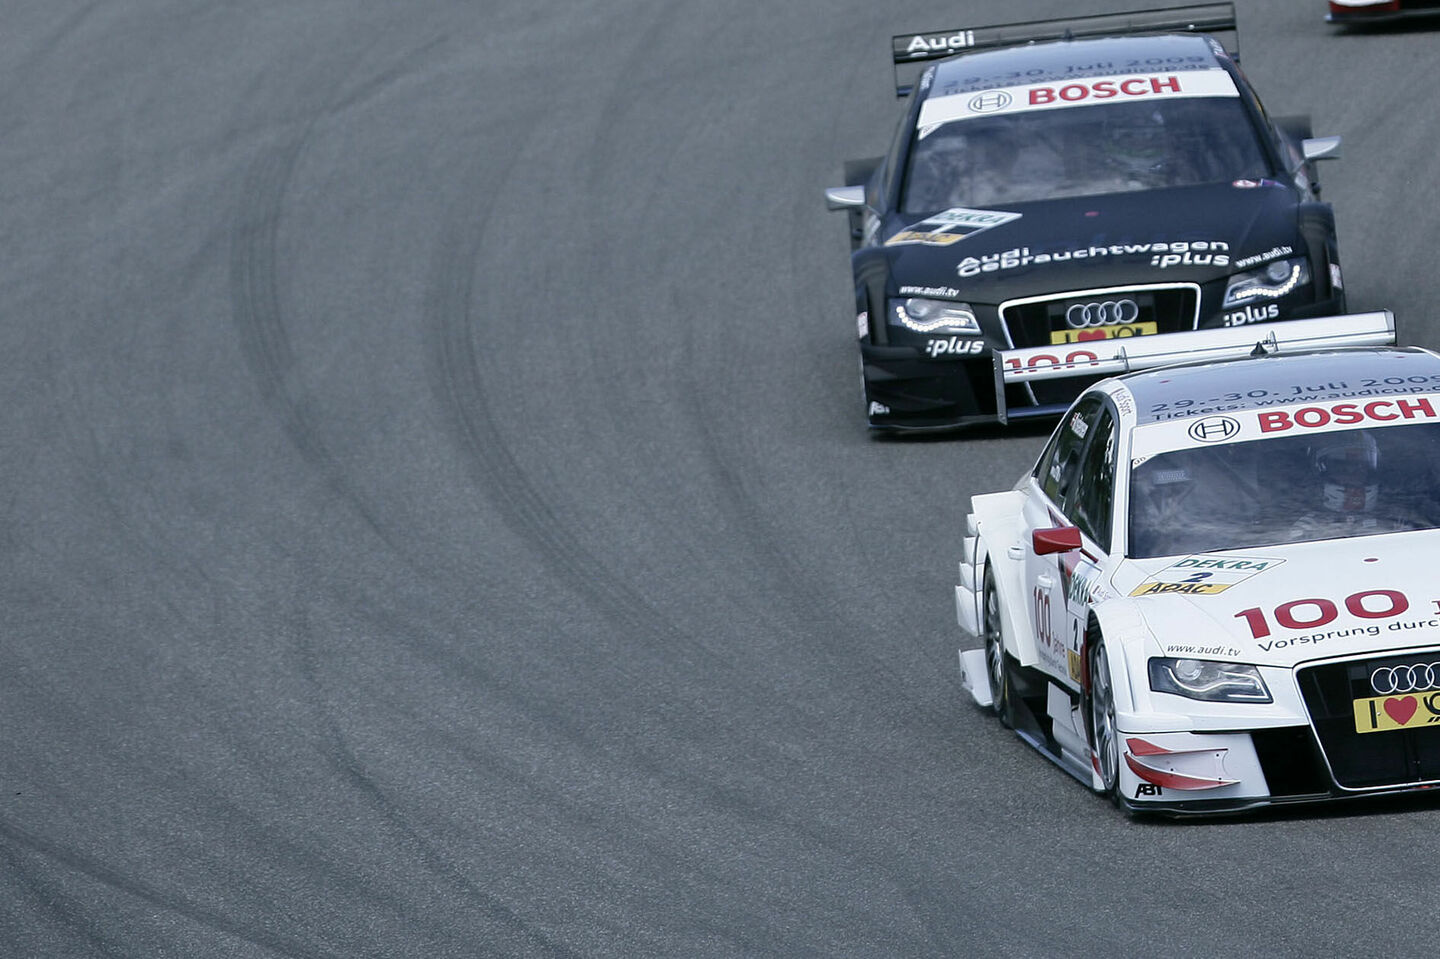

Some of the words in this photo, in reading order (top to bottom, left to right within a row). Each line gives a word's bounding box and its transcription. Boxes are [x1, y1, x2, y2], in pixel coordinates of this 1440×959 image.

[907, 30, 975, 53] Audi
[1028, 76, 1182, 106] BOSCH
[957, 247, 1030, 268] Audi
[1150, 253, 1230, 269] :plus
[1235, 245, 1293, 268] www.audi.tv
[899, 285, 960, 298] www.audi.tv
[926, 336, 985, 358] :plus
[1005, 351, 1099, 374] 100
[1150, 389, 1279, 413] 29.-30.
[1292, 380, 1347, 396] Juli
[1153, 400, 1246, 422] Tickets:
[1257, 398, 1438, 434] BOSCH
[1173, 558, 1269, 571] DEKRA
[1180, 572, 1214, 583] 2
[1233, 589, 1410, 640] 100
[1257, 621, 1381, 653] Vorsprung
[1167, 644, 1242, 657] www.audi.tv
